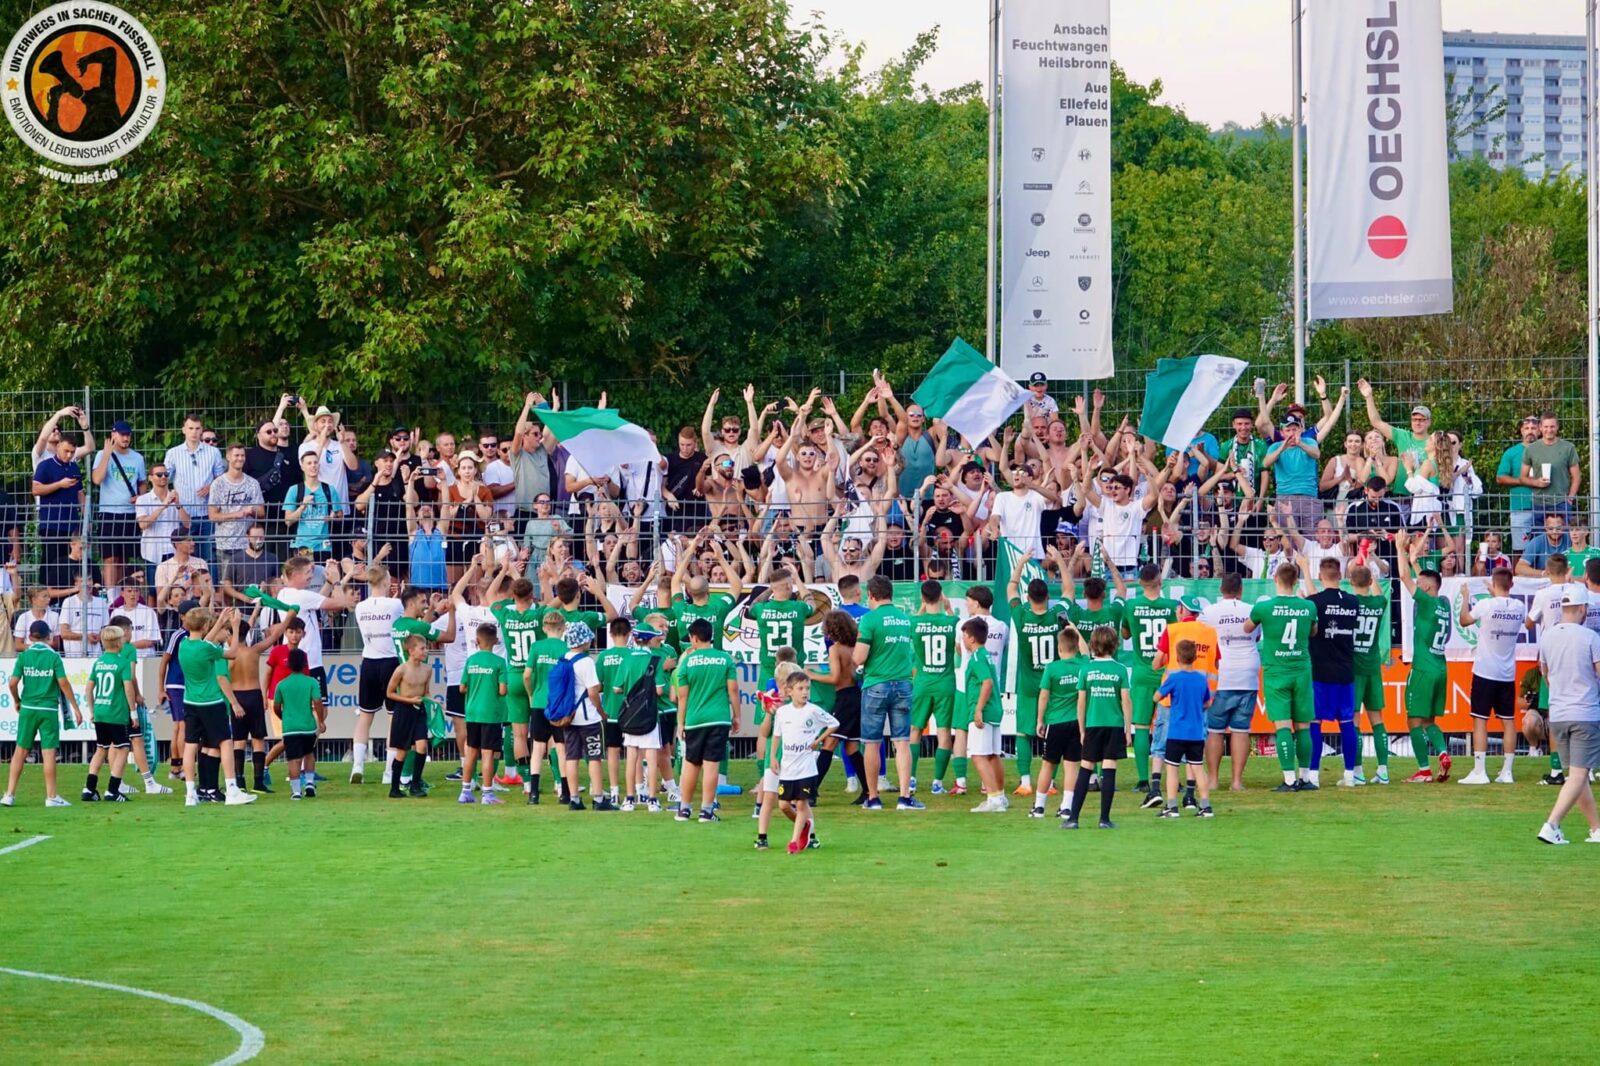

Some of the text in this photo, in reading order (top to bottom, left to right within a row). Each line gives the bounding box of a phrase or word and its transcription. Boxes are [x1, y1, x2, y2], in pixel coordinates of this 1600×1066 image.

[1053, 23, 1108, 36] Ansbach
[1012, 39, 1108, 55] Feuchtwangen
[1039, 56, 1108, 69] Heilsbronn
[1084, 82, 1108, 94] Aue
[1059, 98, 1108, 110] Ellefeld
[1065, 115, 1108, 127] Plauen
[1025, 248, 1050, 259] Jeep
[1328, 291, 1440, 306] www.oechsler.com
[761, 609, 798, 620] ansbach
[1134, 606, 1171, 616] ansbach
[1272, 607, 1309, 616] ansbach
[1325, 606, 1357, 616] ansbach
[505, 619, 539, 630] ansbach
[915, 623, 953, 633] ansbach
[1022, 623, 1058, 634] ansbach
[767, 620, 793, 651] 23
[1281, 619, 1297, 650] 4
[1353, 616, 1378, 647] 29
[508, 630, 537, 662] 30
[921, 635, 947, 666] 18
[1028, 635, 1054, 664] 10
[687, 656, 727, 667] ansbach
[1087, 672, 1120, 683] ansbach
[96, 672, 115, 697] 10
[586, 734, 601, 756] 932
